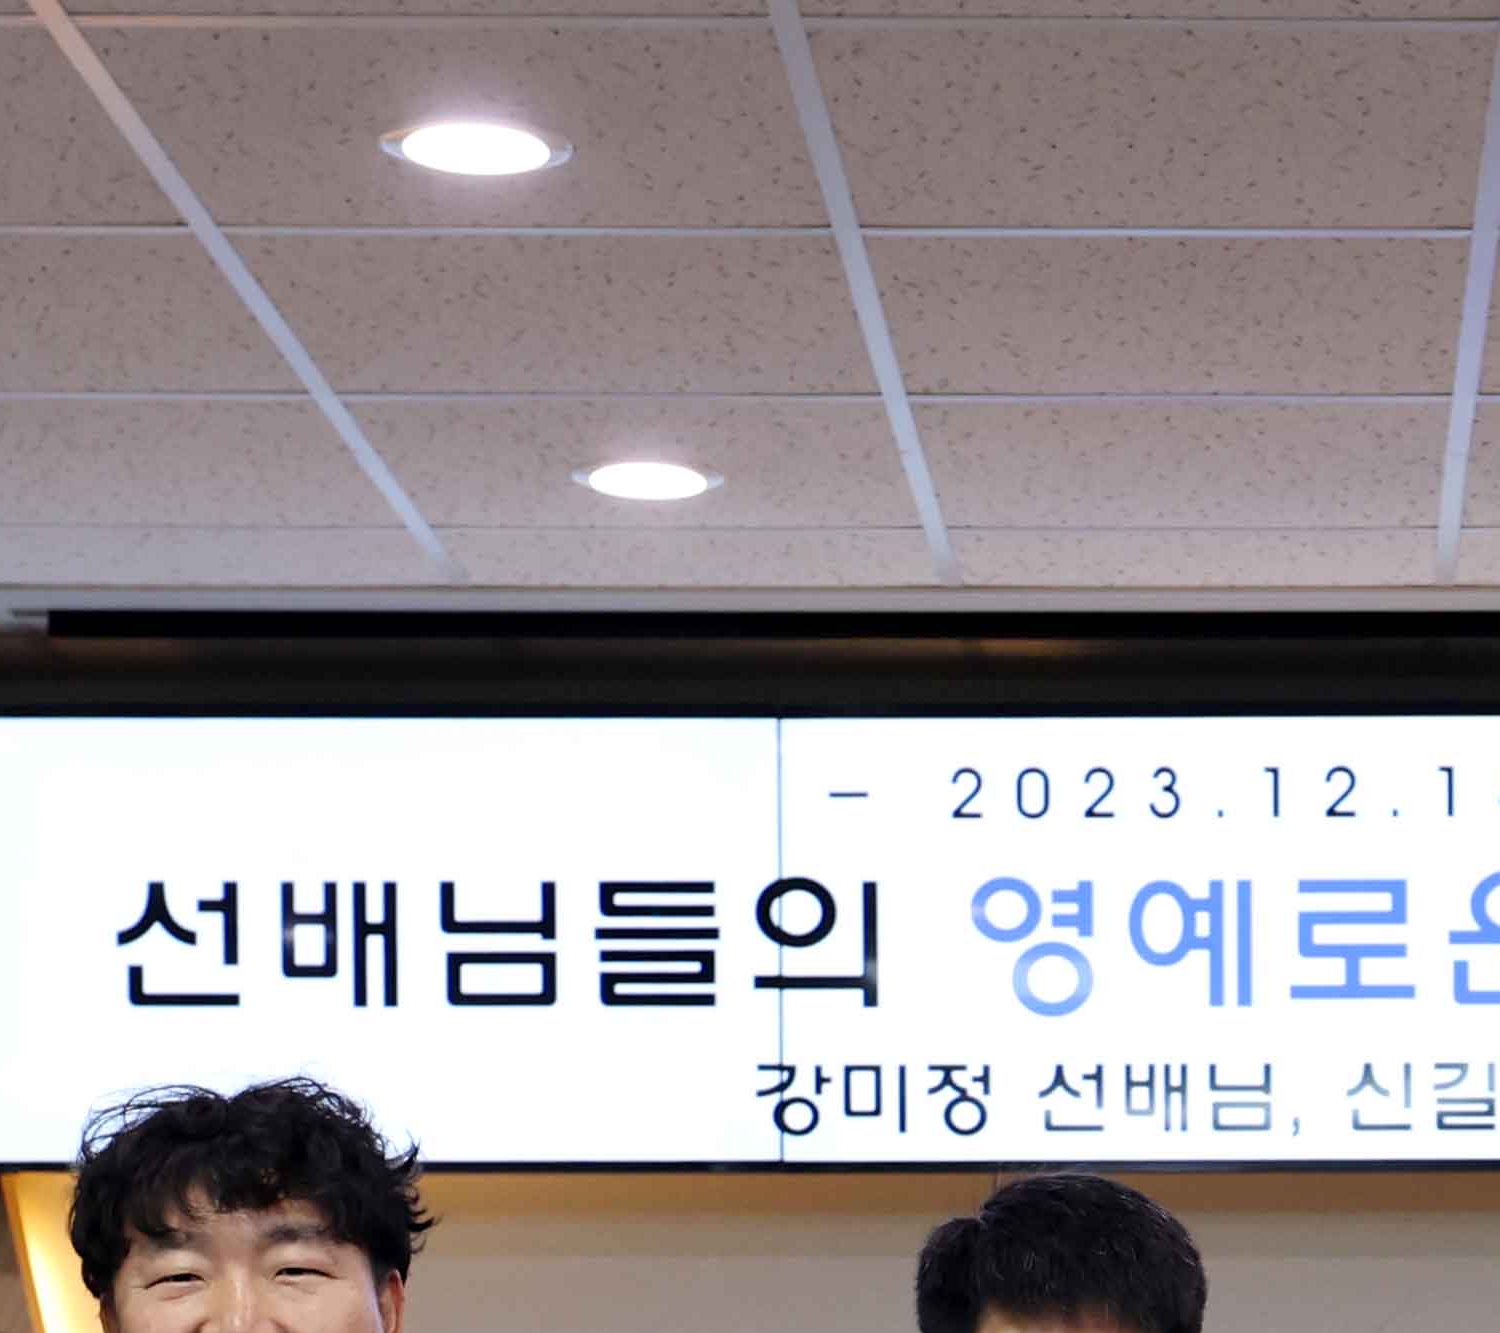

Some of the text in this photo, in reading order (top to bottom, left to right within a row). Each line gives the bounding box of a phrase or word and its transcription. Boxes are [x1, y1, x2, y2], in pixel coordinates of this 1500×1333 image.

[115, 876, 880, 1009] 선배님들의
[754, 1060, 992, 1138] 강미정
[1037, 1060, 1301, 1138] 선배님,
